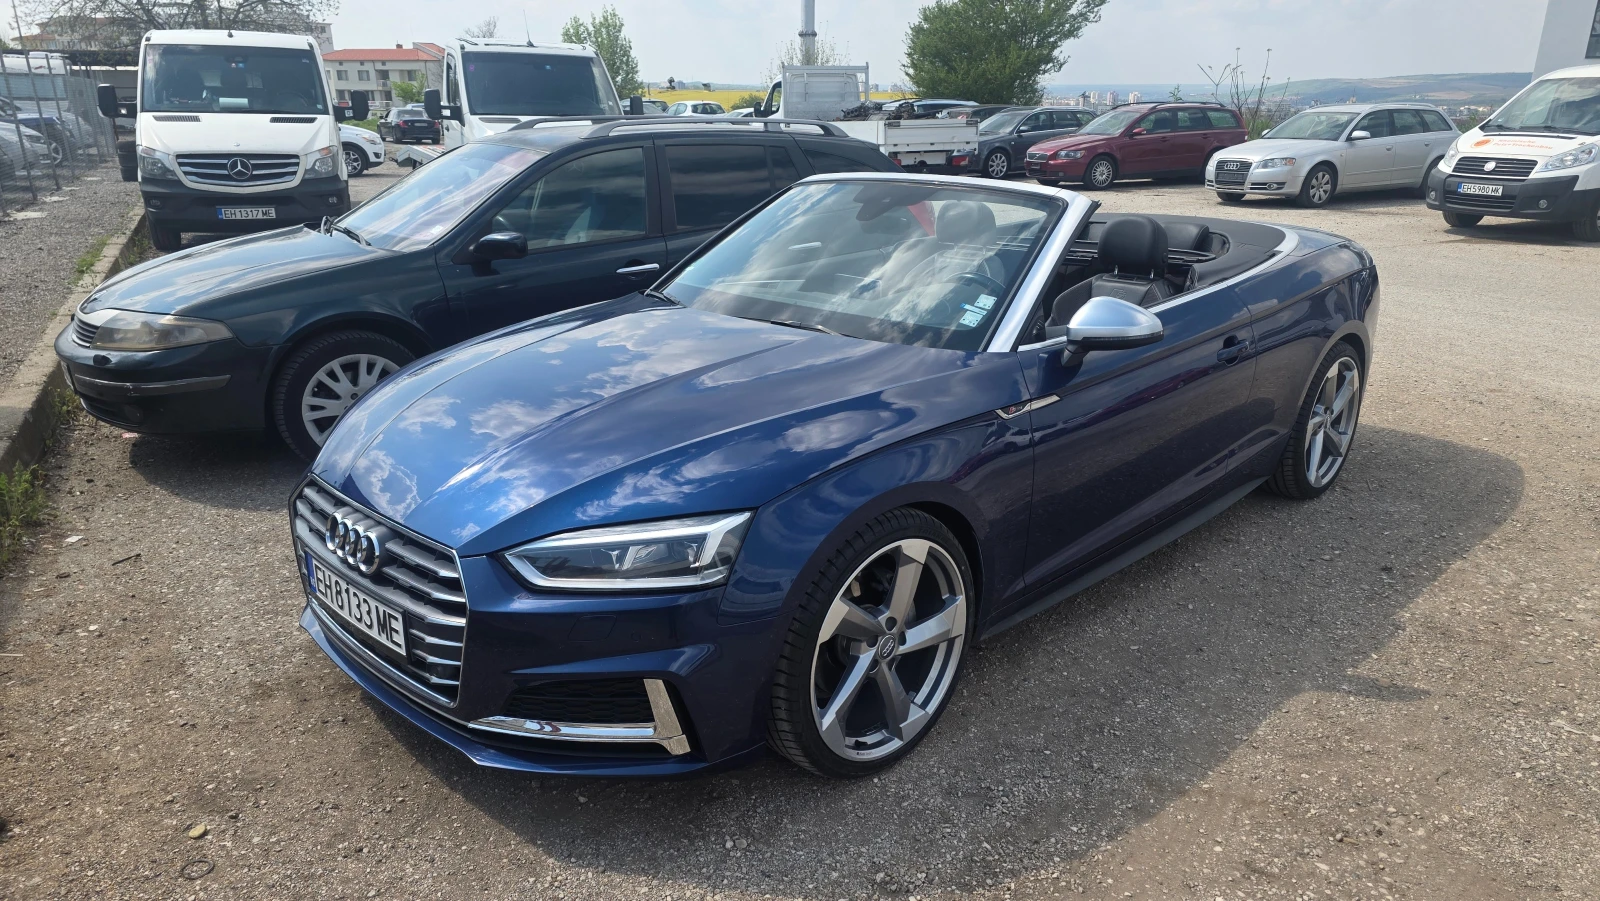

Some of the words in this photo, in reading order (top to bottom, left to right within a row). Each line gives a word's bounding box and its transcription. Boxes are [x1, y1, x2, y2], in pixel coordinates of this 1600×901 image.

[238, 209, 260, 218] 1317
[314, 563, 334, 605] EH
[334, 579, 374, 630] 8133
[375, 604, 402, 649] ME
